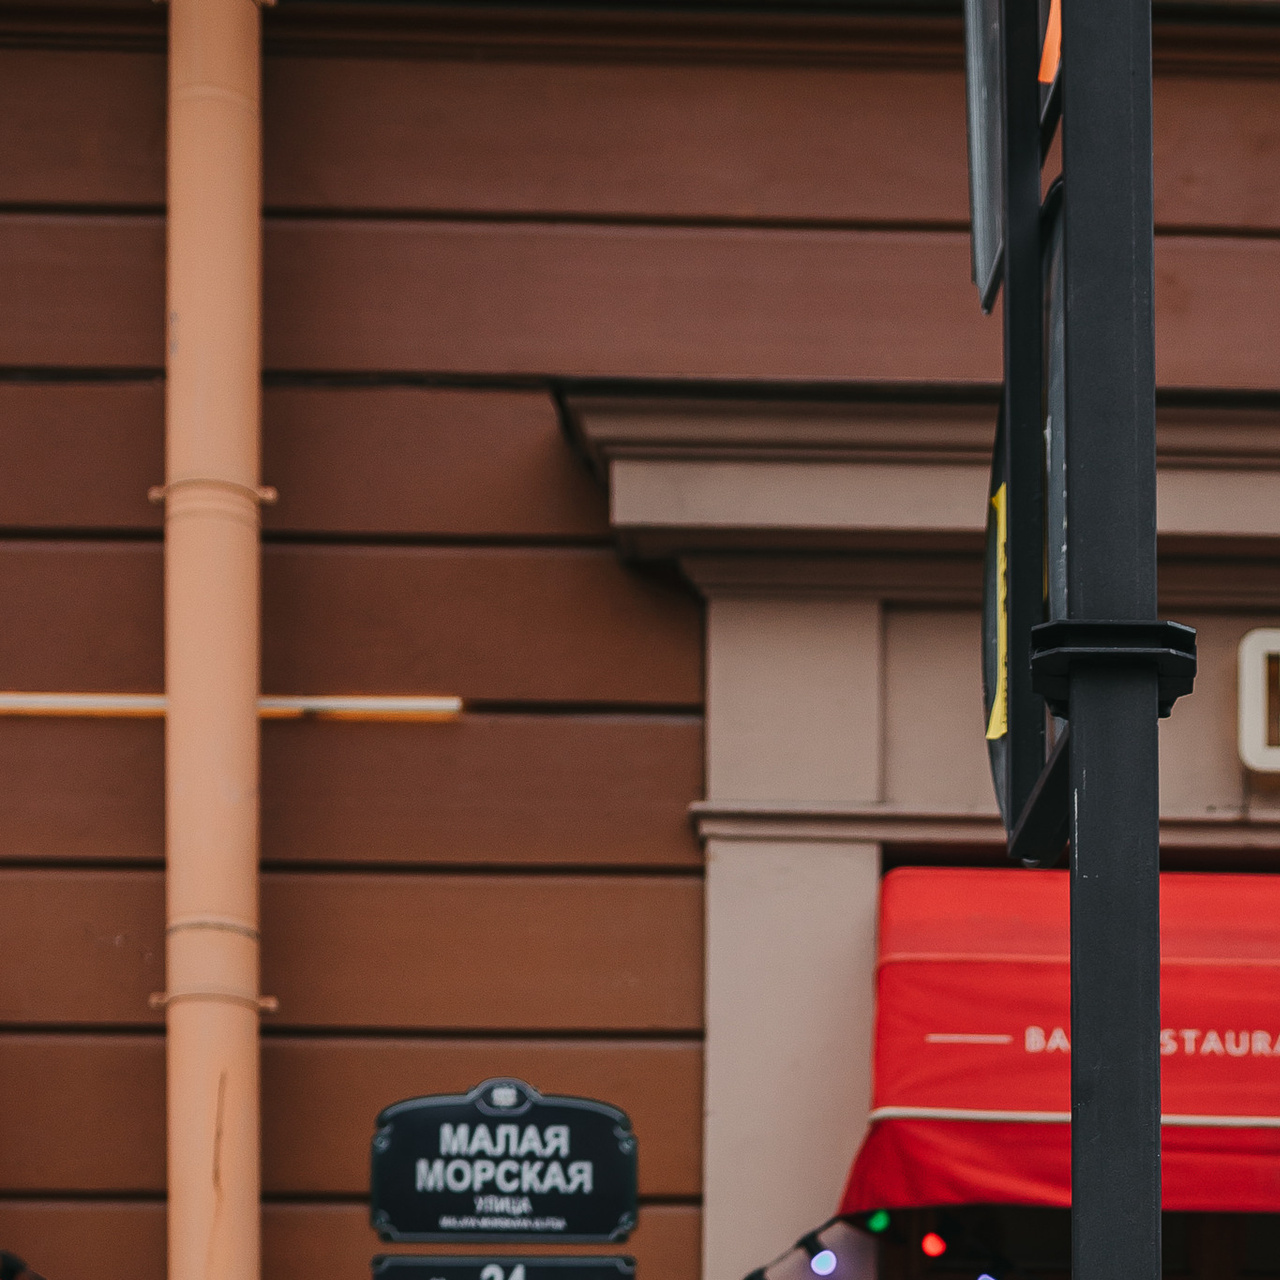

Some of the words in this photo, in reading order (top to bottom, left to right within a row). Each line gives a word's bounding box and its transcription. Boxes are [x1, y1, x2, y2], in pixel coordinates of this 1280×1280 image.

[1024, 1025, 1071, 1054] BA
[438, 1122, 571, 1157] МАЛАЯ
[415, 1158, 594, 1194] МОРСКАЯ
